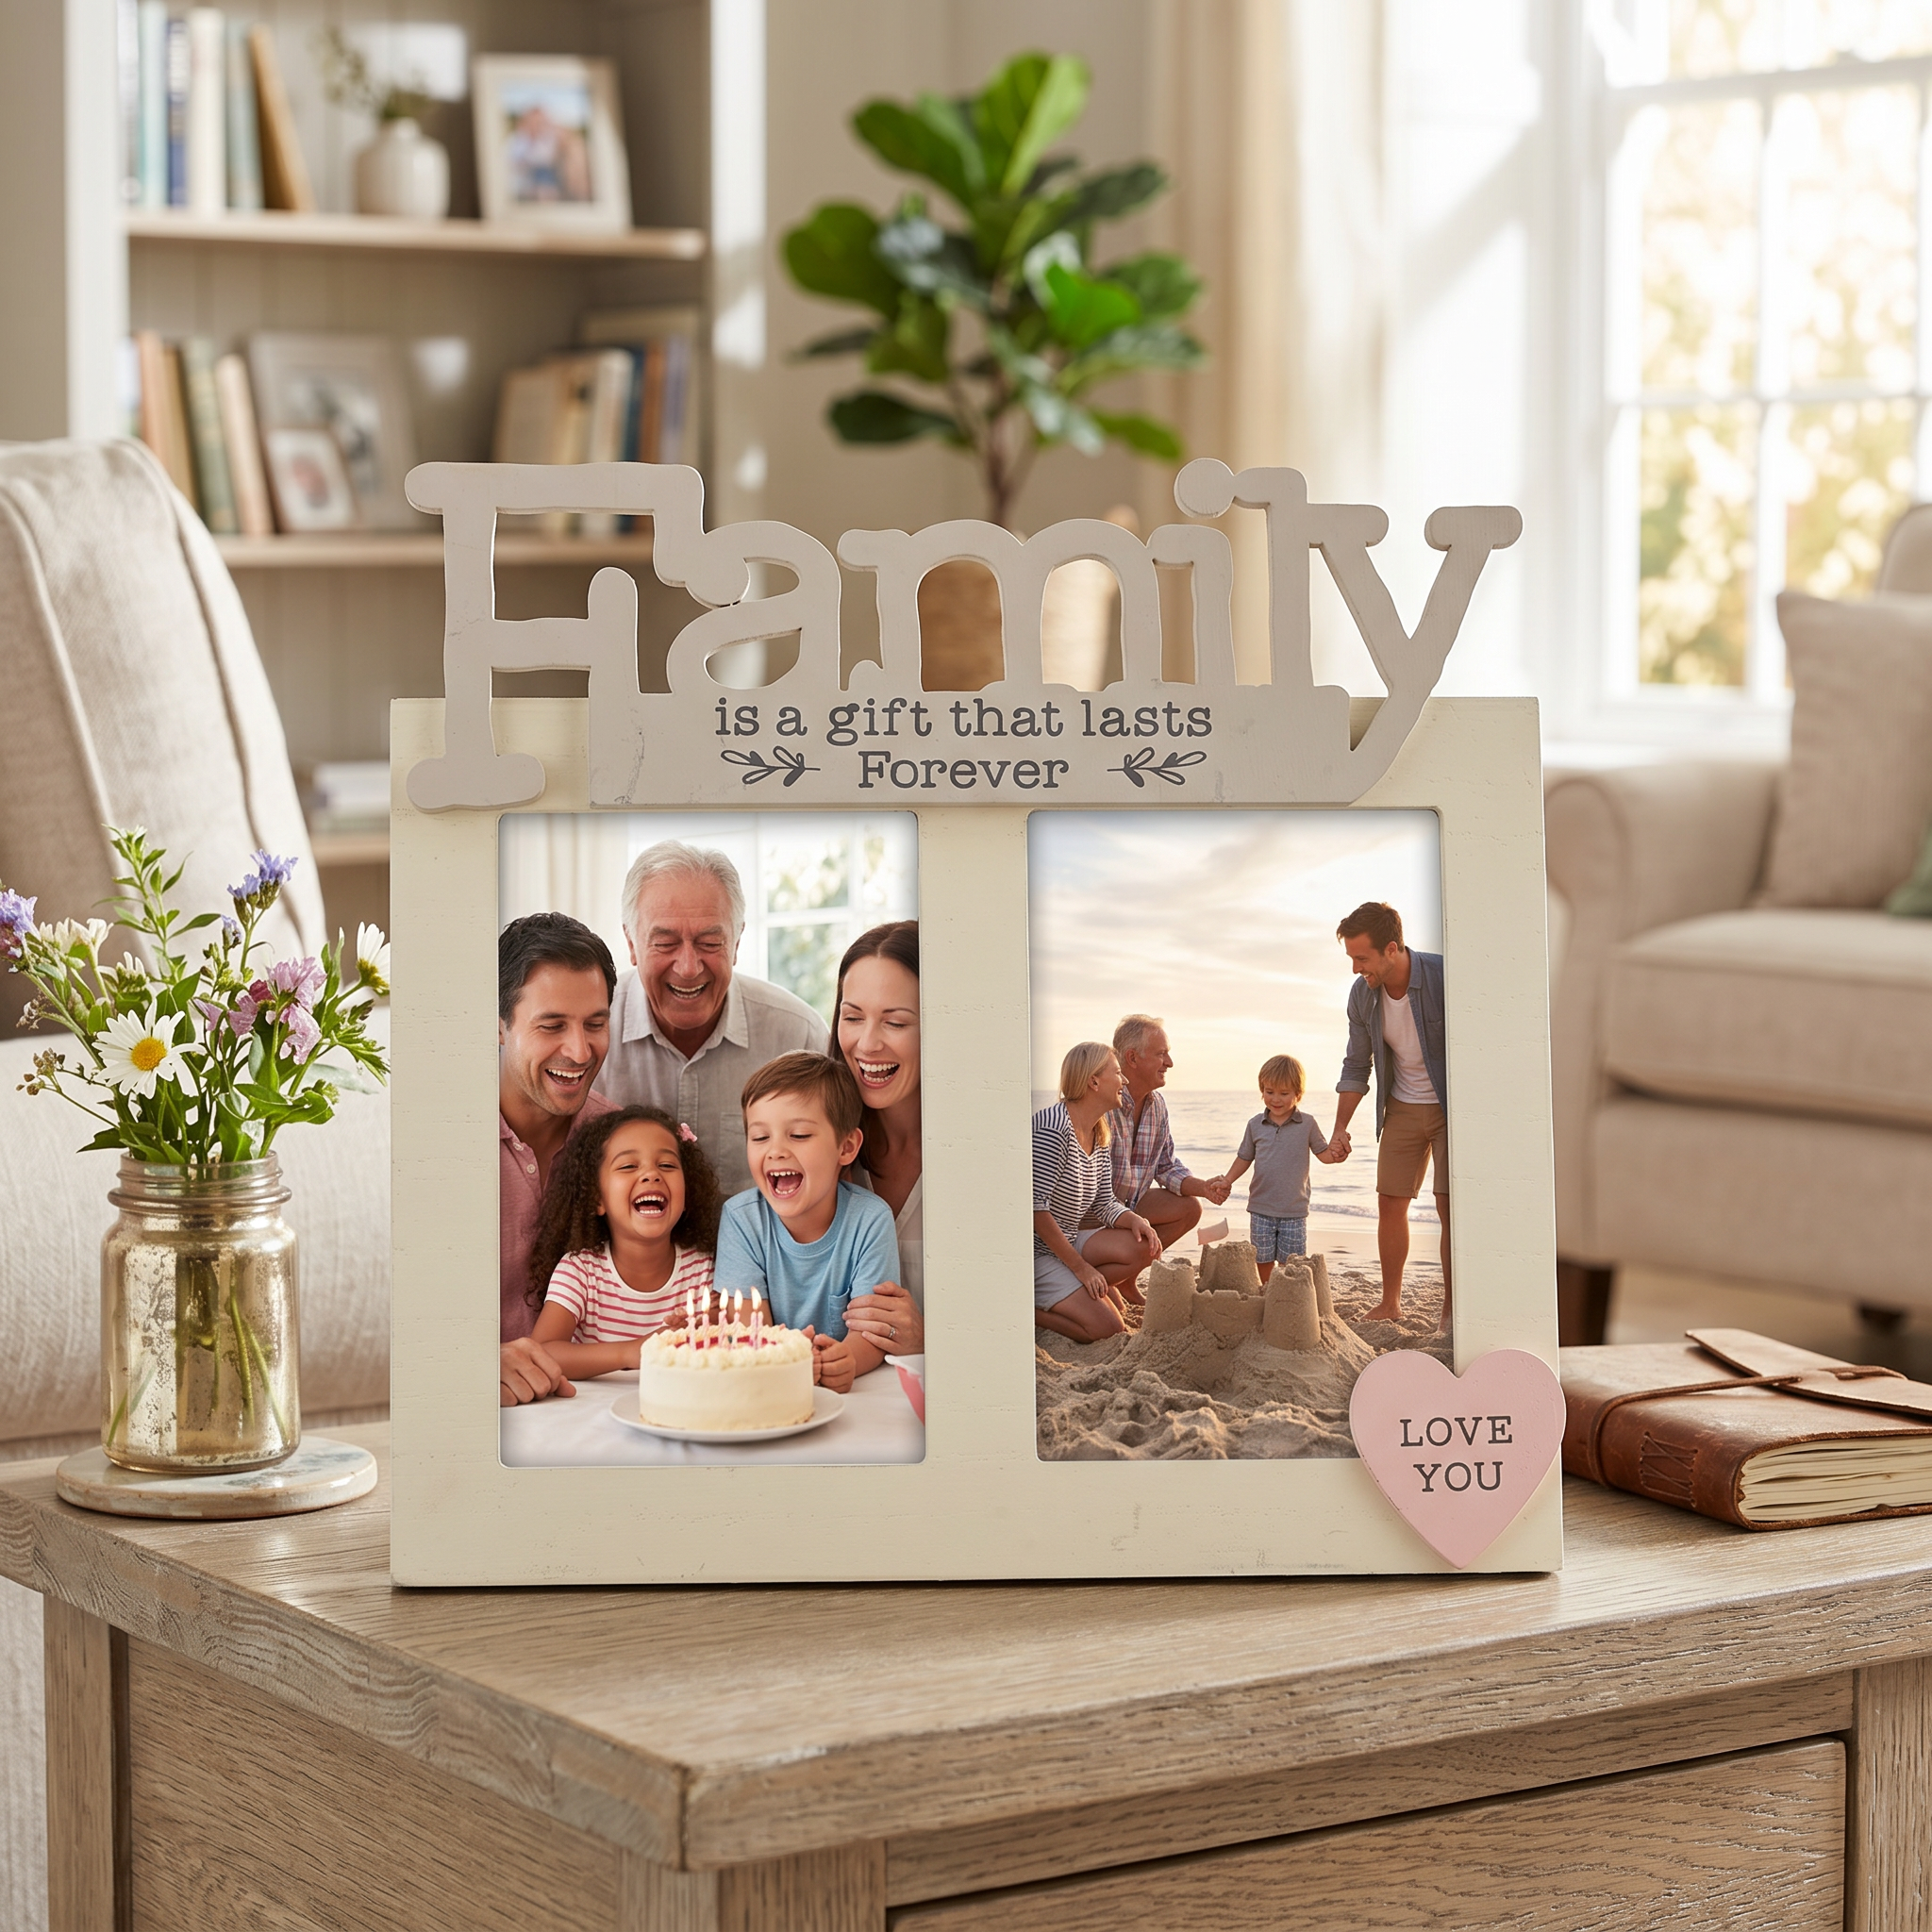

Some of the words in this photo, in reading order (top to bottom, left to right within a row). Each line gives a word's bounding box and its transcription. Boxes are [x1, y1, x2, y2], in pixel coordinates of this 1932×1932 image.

[406, 458, 1524, 812] Family
[714, 697, 760, 737] is
[775, 705, 808, 737] a
[825, 697, 933, 747] gift
[948, 697, 1064, 738] that
[1080, 699, 1213, 738] lasts
[858, 750, 1070, 790] Forever
[1399, 1415, 1513, 1447] LOVE
[1412, 1460, 1504, 1492] YOU
